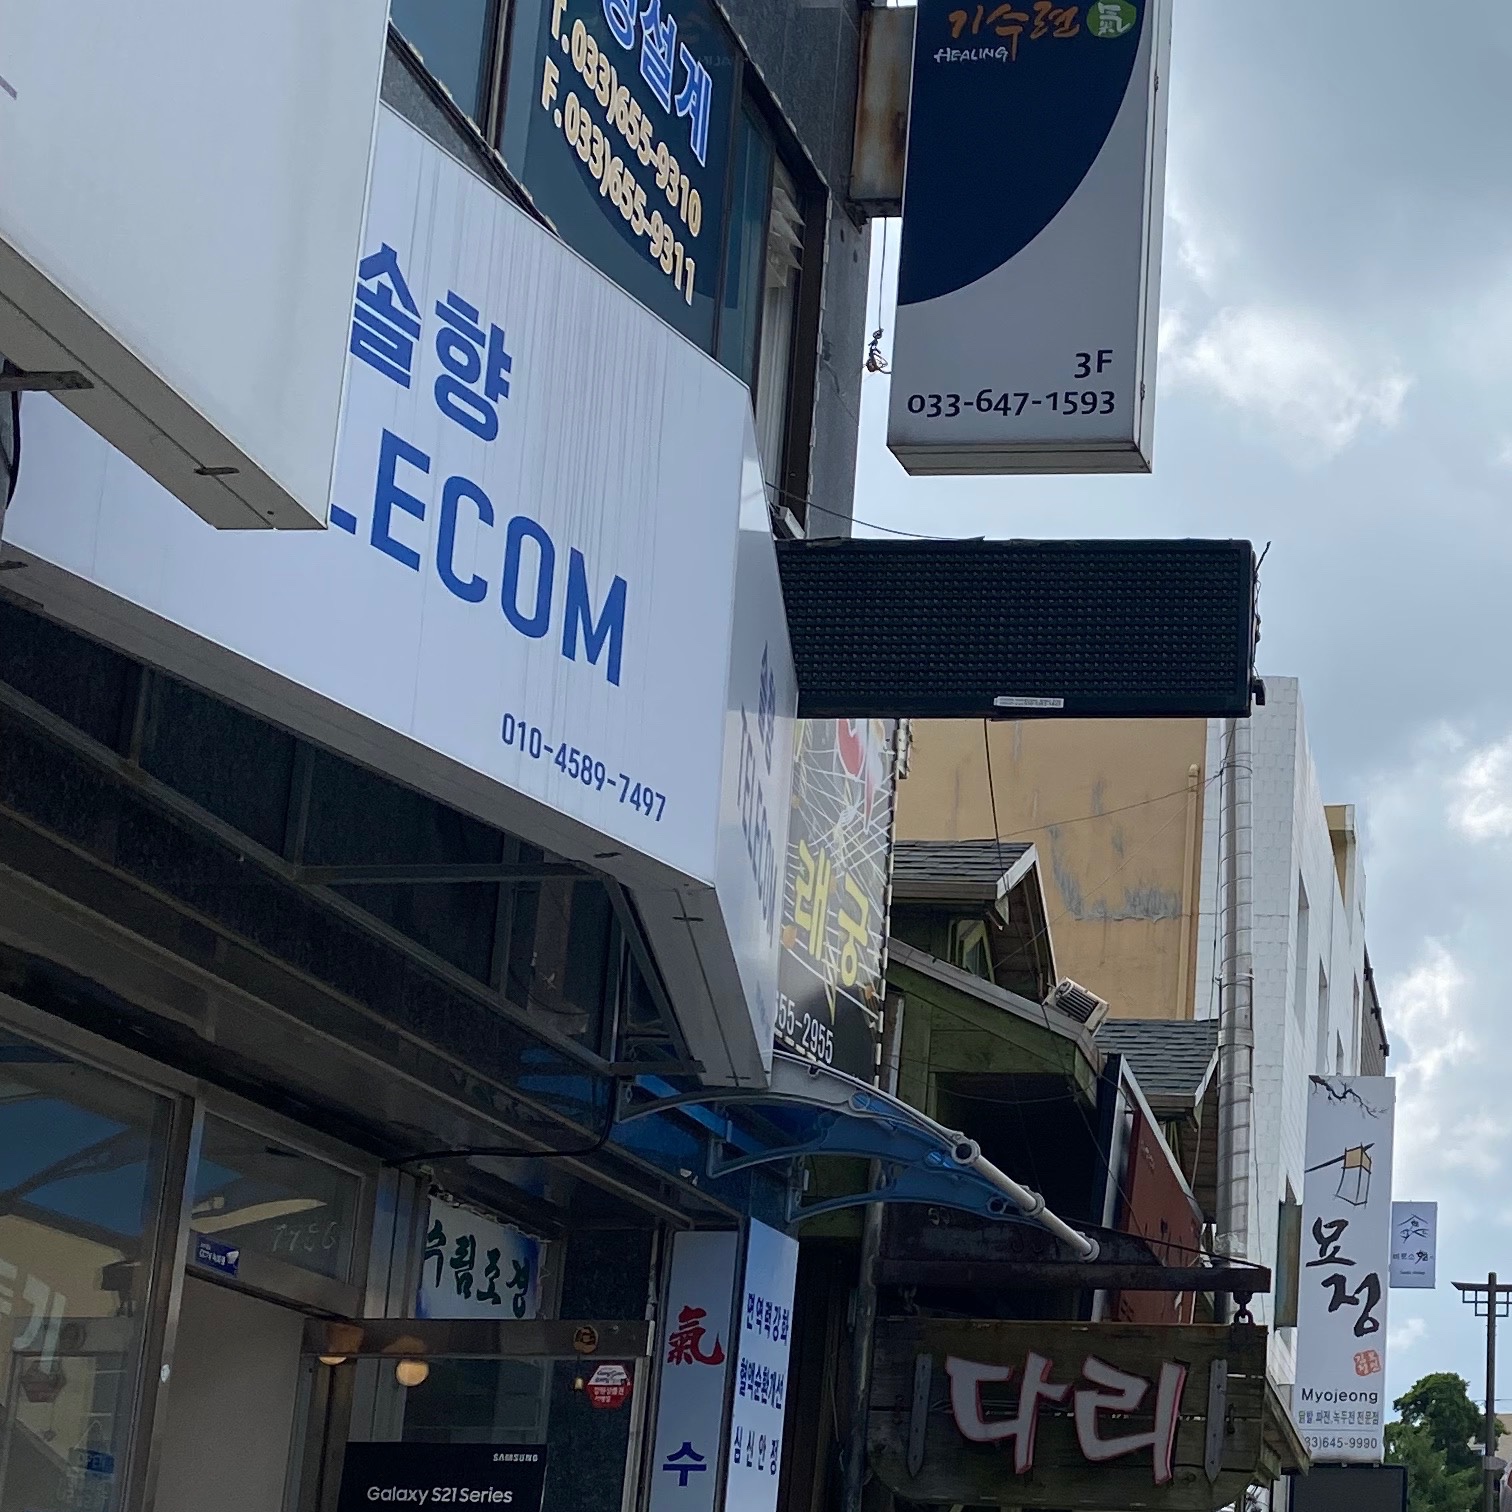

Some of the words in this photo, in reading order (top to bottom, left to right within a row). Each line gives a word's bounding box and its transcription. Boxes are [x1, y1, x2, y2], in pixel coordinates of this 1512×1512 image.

[934, 46, 1009, 63] HEALING
[541, 55, 695, 306] F.033)655-9311
[350, 242, 514, 442] 솔향
[1074, 349, 1113, 378] 3F
[907, 389, 1115, 417] 033-647-1593
[330, 427, 628, 688] ECOM
[501, 712, 667, 823] 010-4589-7497
[776, 989, 834, 1064] 55-2955
[945, 1349, 1191, 1485] 다리
[1301, 1387, 1379, 1404] Myojeong
[493, 1453, 538, 1462] SAMSUNG
[367, 1486, 429, 1505] Galaxy
[431, 1487, 457, 1502] S21
[459, 1486, 513, 1503] Series
